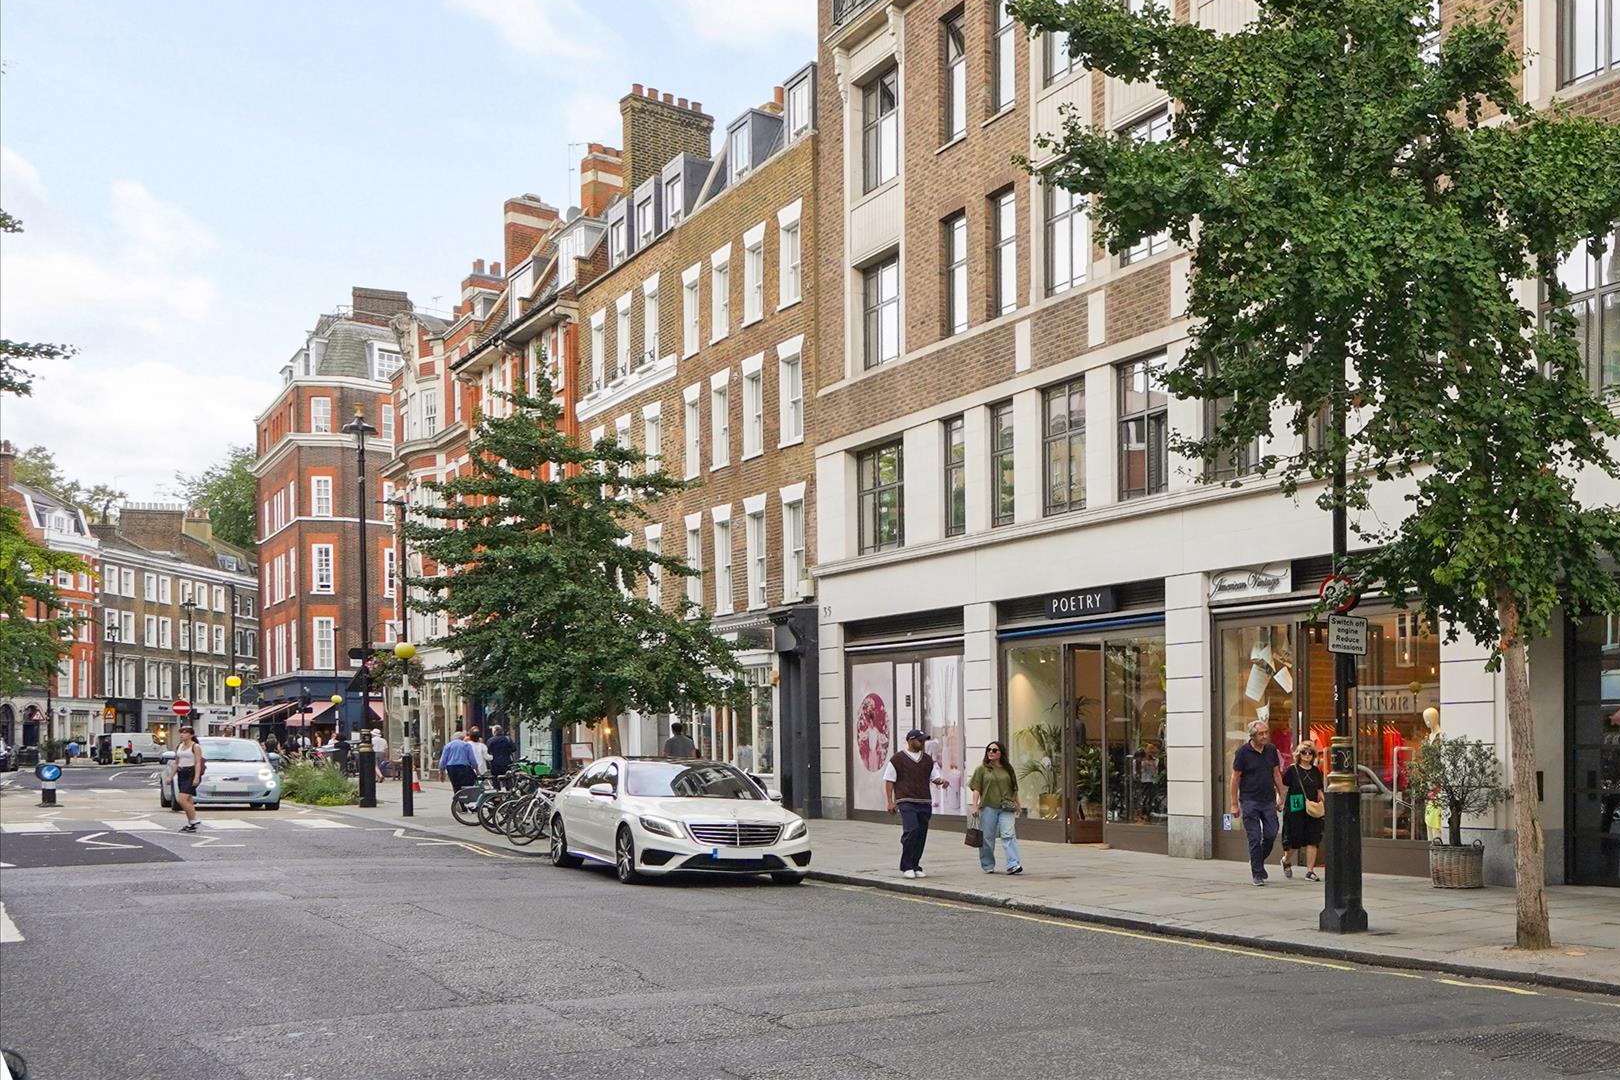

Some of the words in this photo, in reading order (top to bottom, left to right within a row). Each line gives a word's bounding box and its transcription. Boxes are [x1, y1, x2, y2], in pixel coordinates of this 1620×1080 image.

[1052, 593, 1101, 613] POETRY
[1331, 617, 1353, 627] Switch
[1337, 627, 1358, 635] engine
[1336, 635, 1359, 644] Reduce
[1332, 642, 1363, 652] emissions
